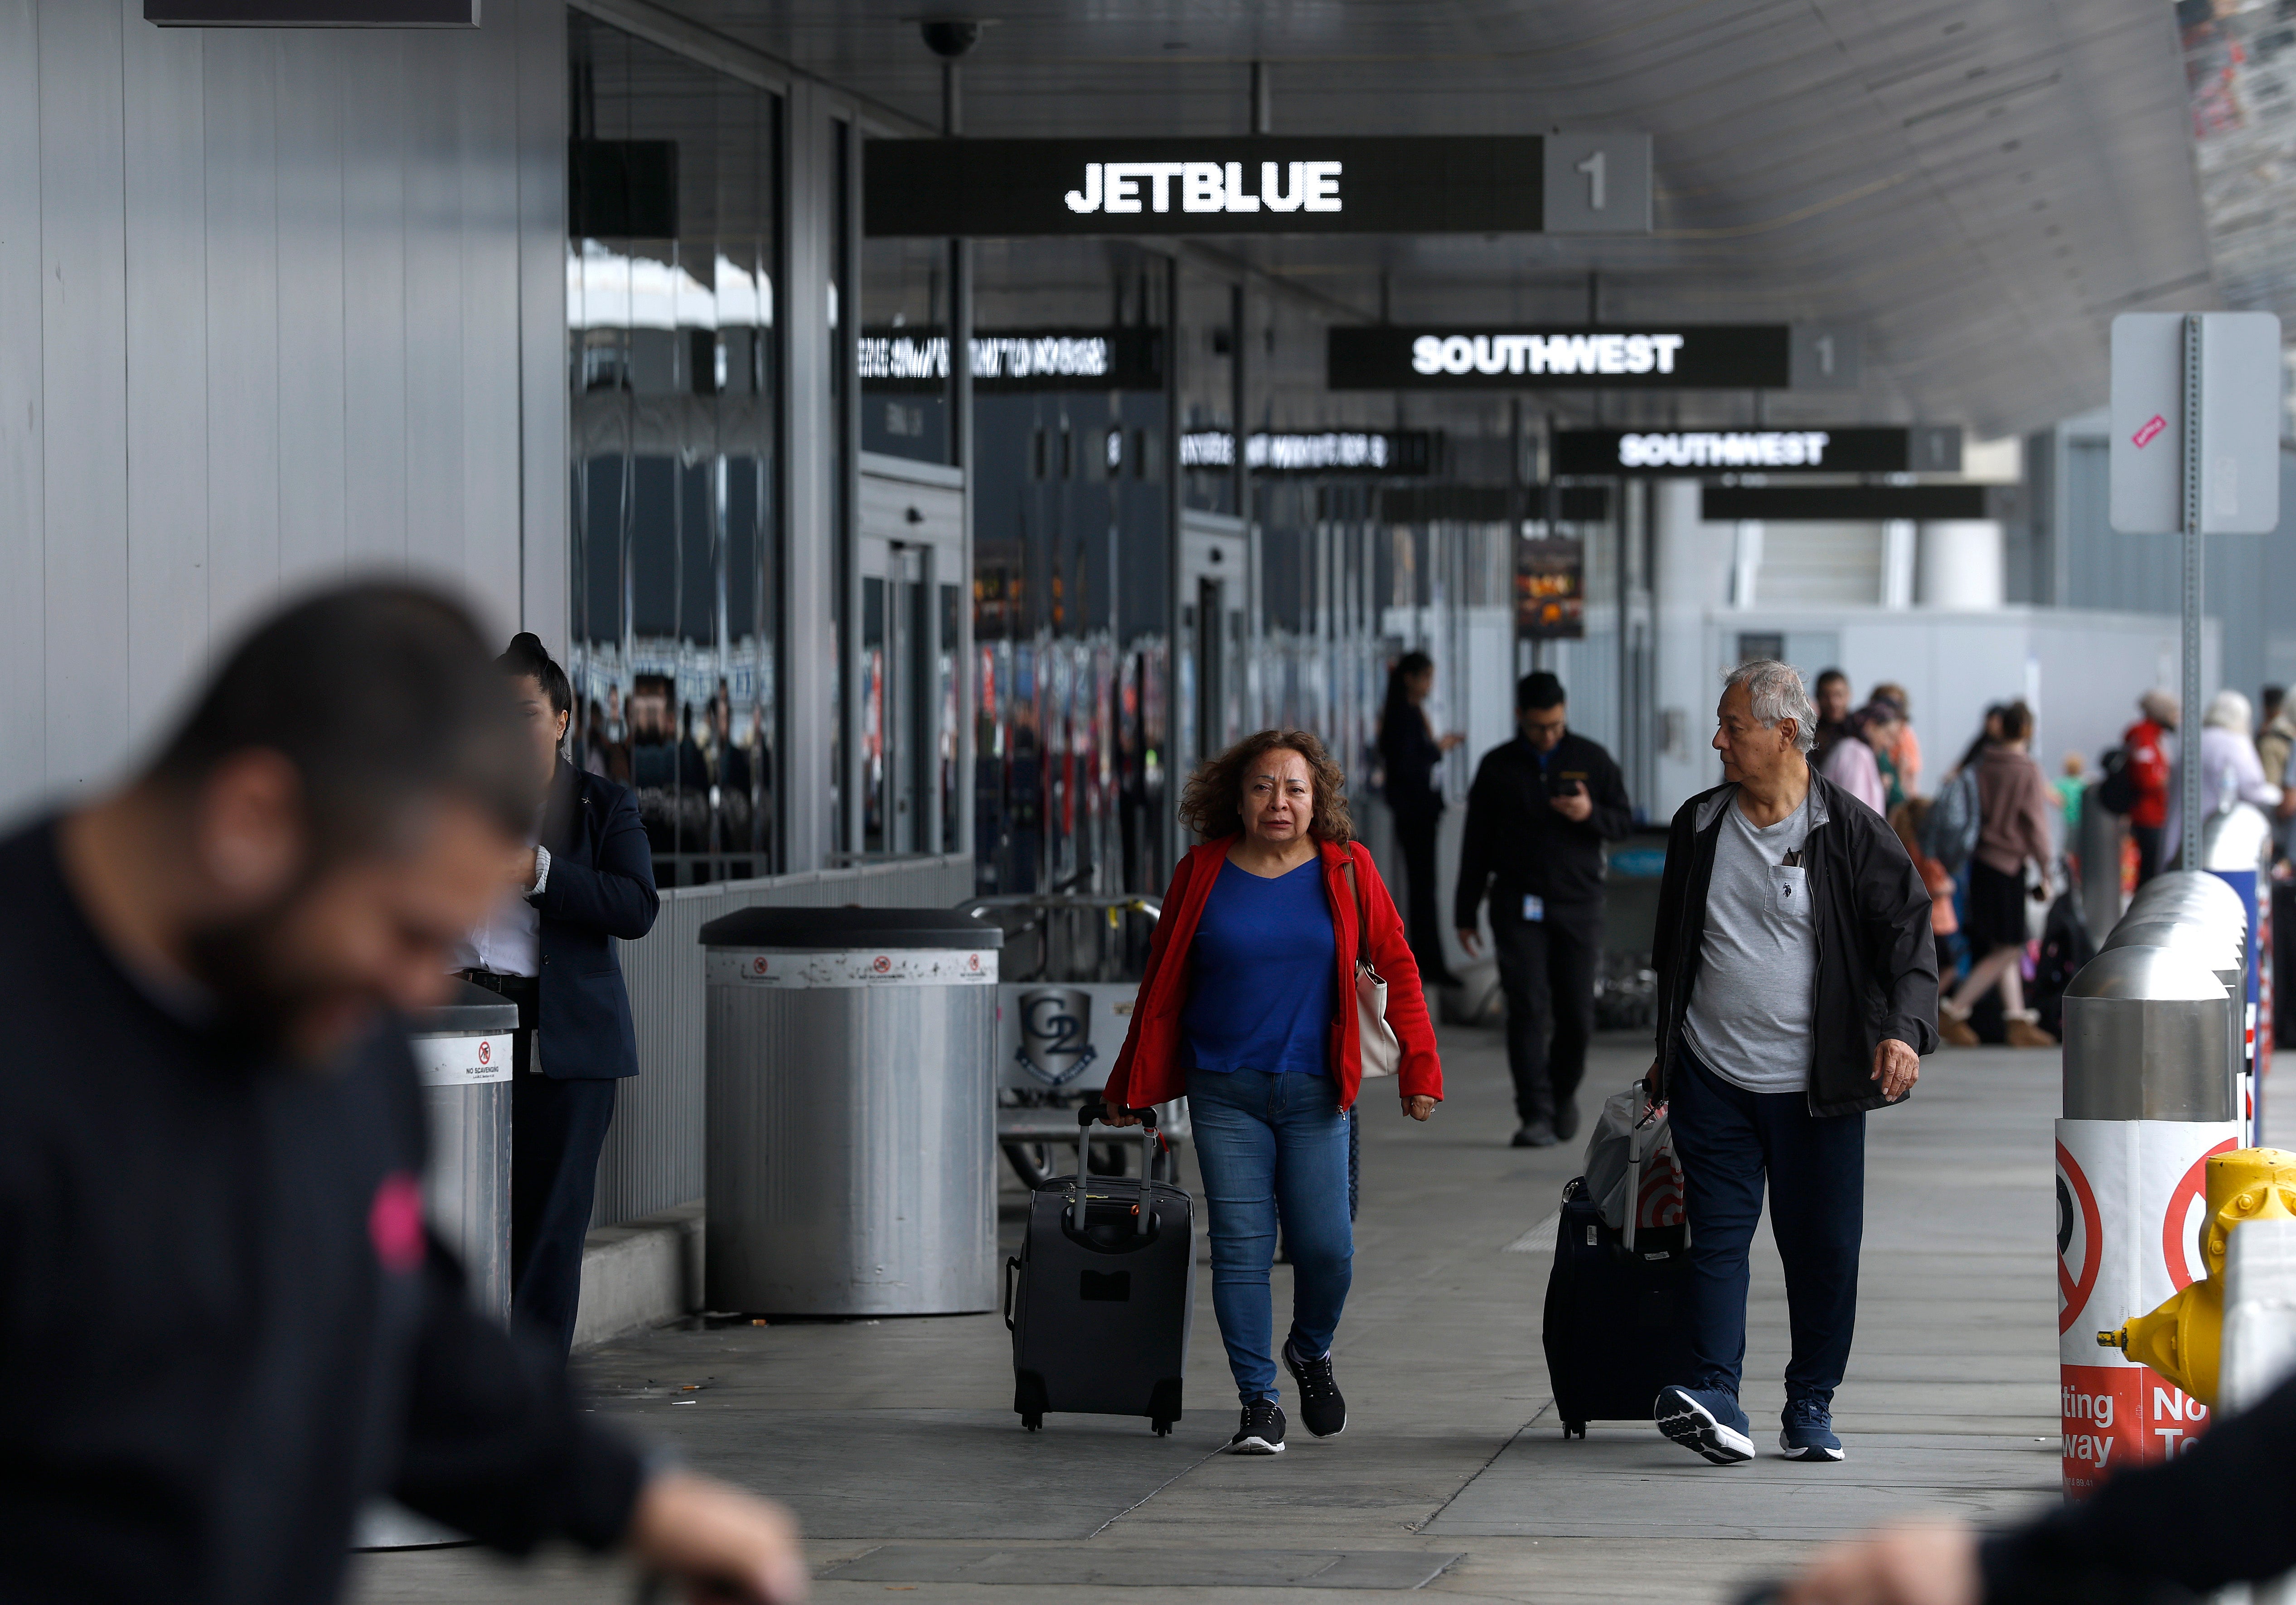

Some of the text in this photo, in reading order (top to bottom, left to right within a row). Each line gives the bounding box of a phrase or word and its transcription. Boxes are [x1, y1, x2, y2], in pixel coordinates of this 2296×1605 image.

[1064, 160, 1342, 213] JETBLUE
[1576, 151, 1607, 209] 1
[1411, 334, 1684, 375] SOUTHWEST
[1816, 334, 1834, 376] 1
[1618, 431, 1831, 466] SOUTHWEST
[2154, 1387, 2207, 1421] No
[2062, 1433, 2114, 1468] way
[2076, 1479, 2093, 1487] 89.41
